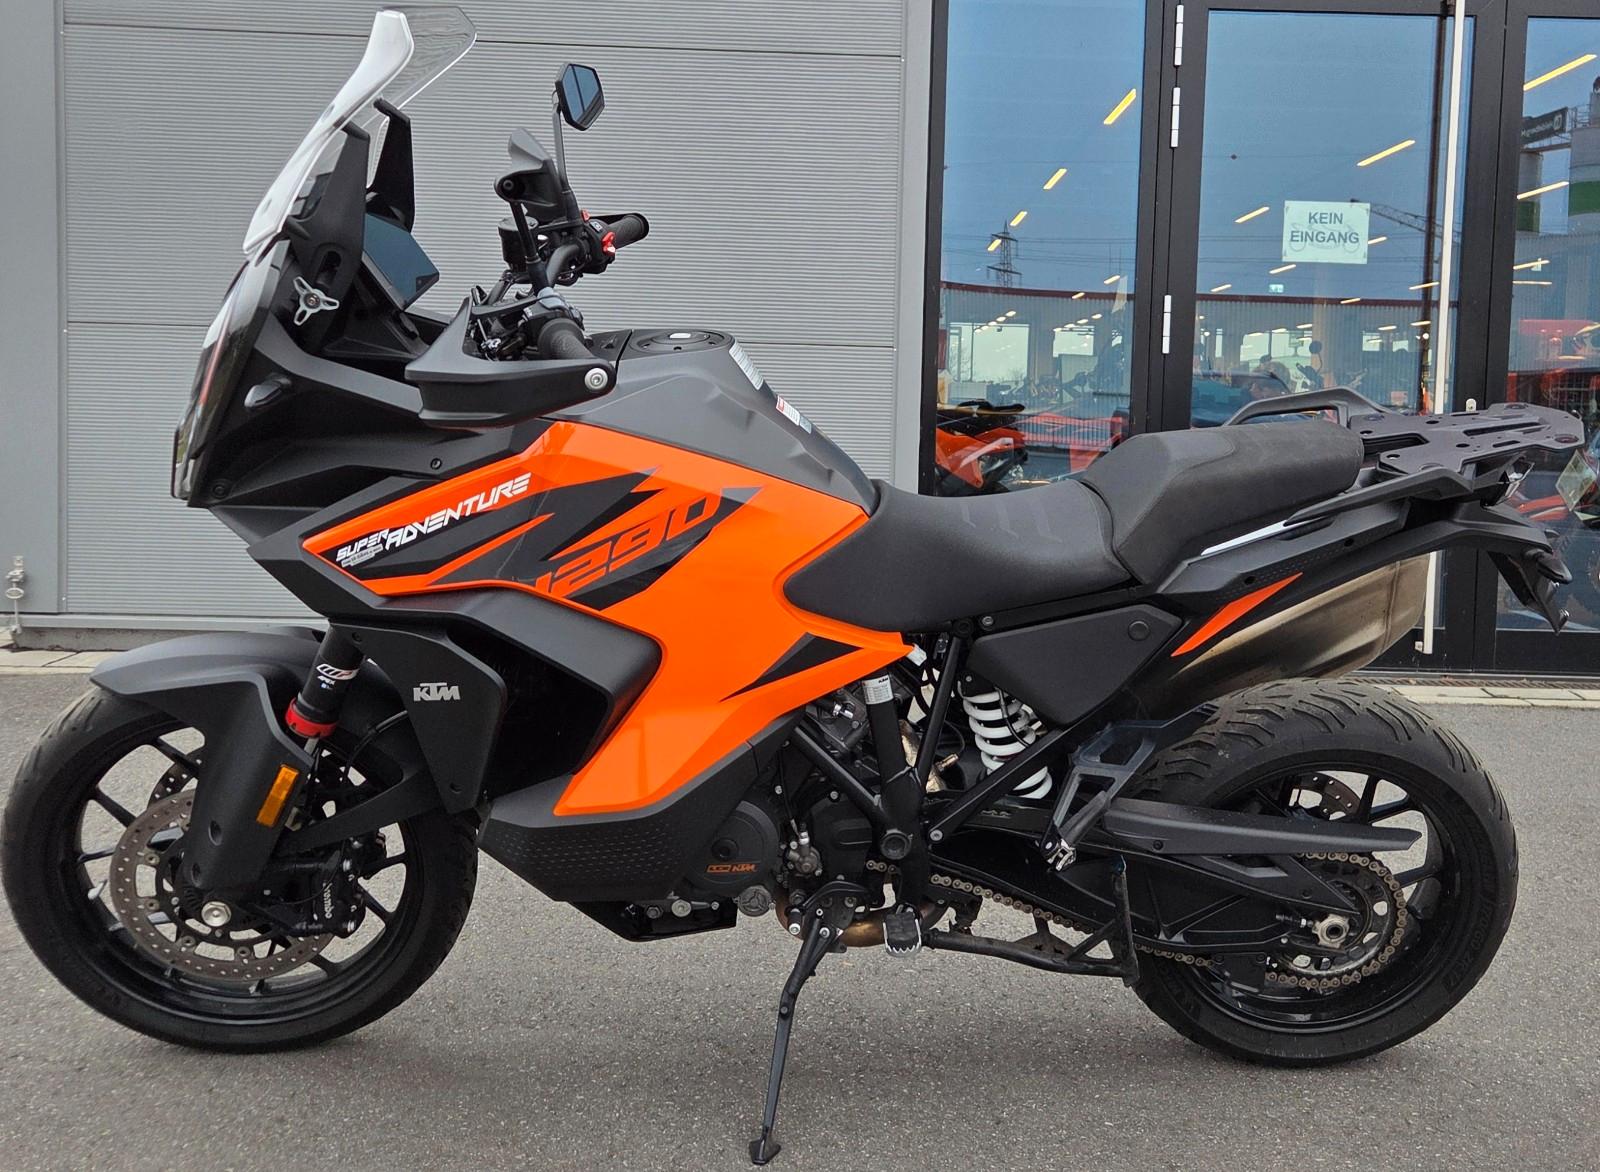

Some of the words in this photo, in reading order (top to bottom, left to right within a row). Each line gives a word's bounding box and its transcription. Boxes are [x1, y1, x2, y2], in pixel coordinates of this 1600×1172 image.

[1309, 212, 1343, 225] KEIN
[1290, 231, 1360, 244] EINGANG
[336, 528, 390, 562] SUPER
[385, 472, 533, 551] ADVENTURE
[536, 488, 723, 598] 1290
[413, 682, 461, 702] KTM
